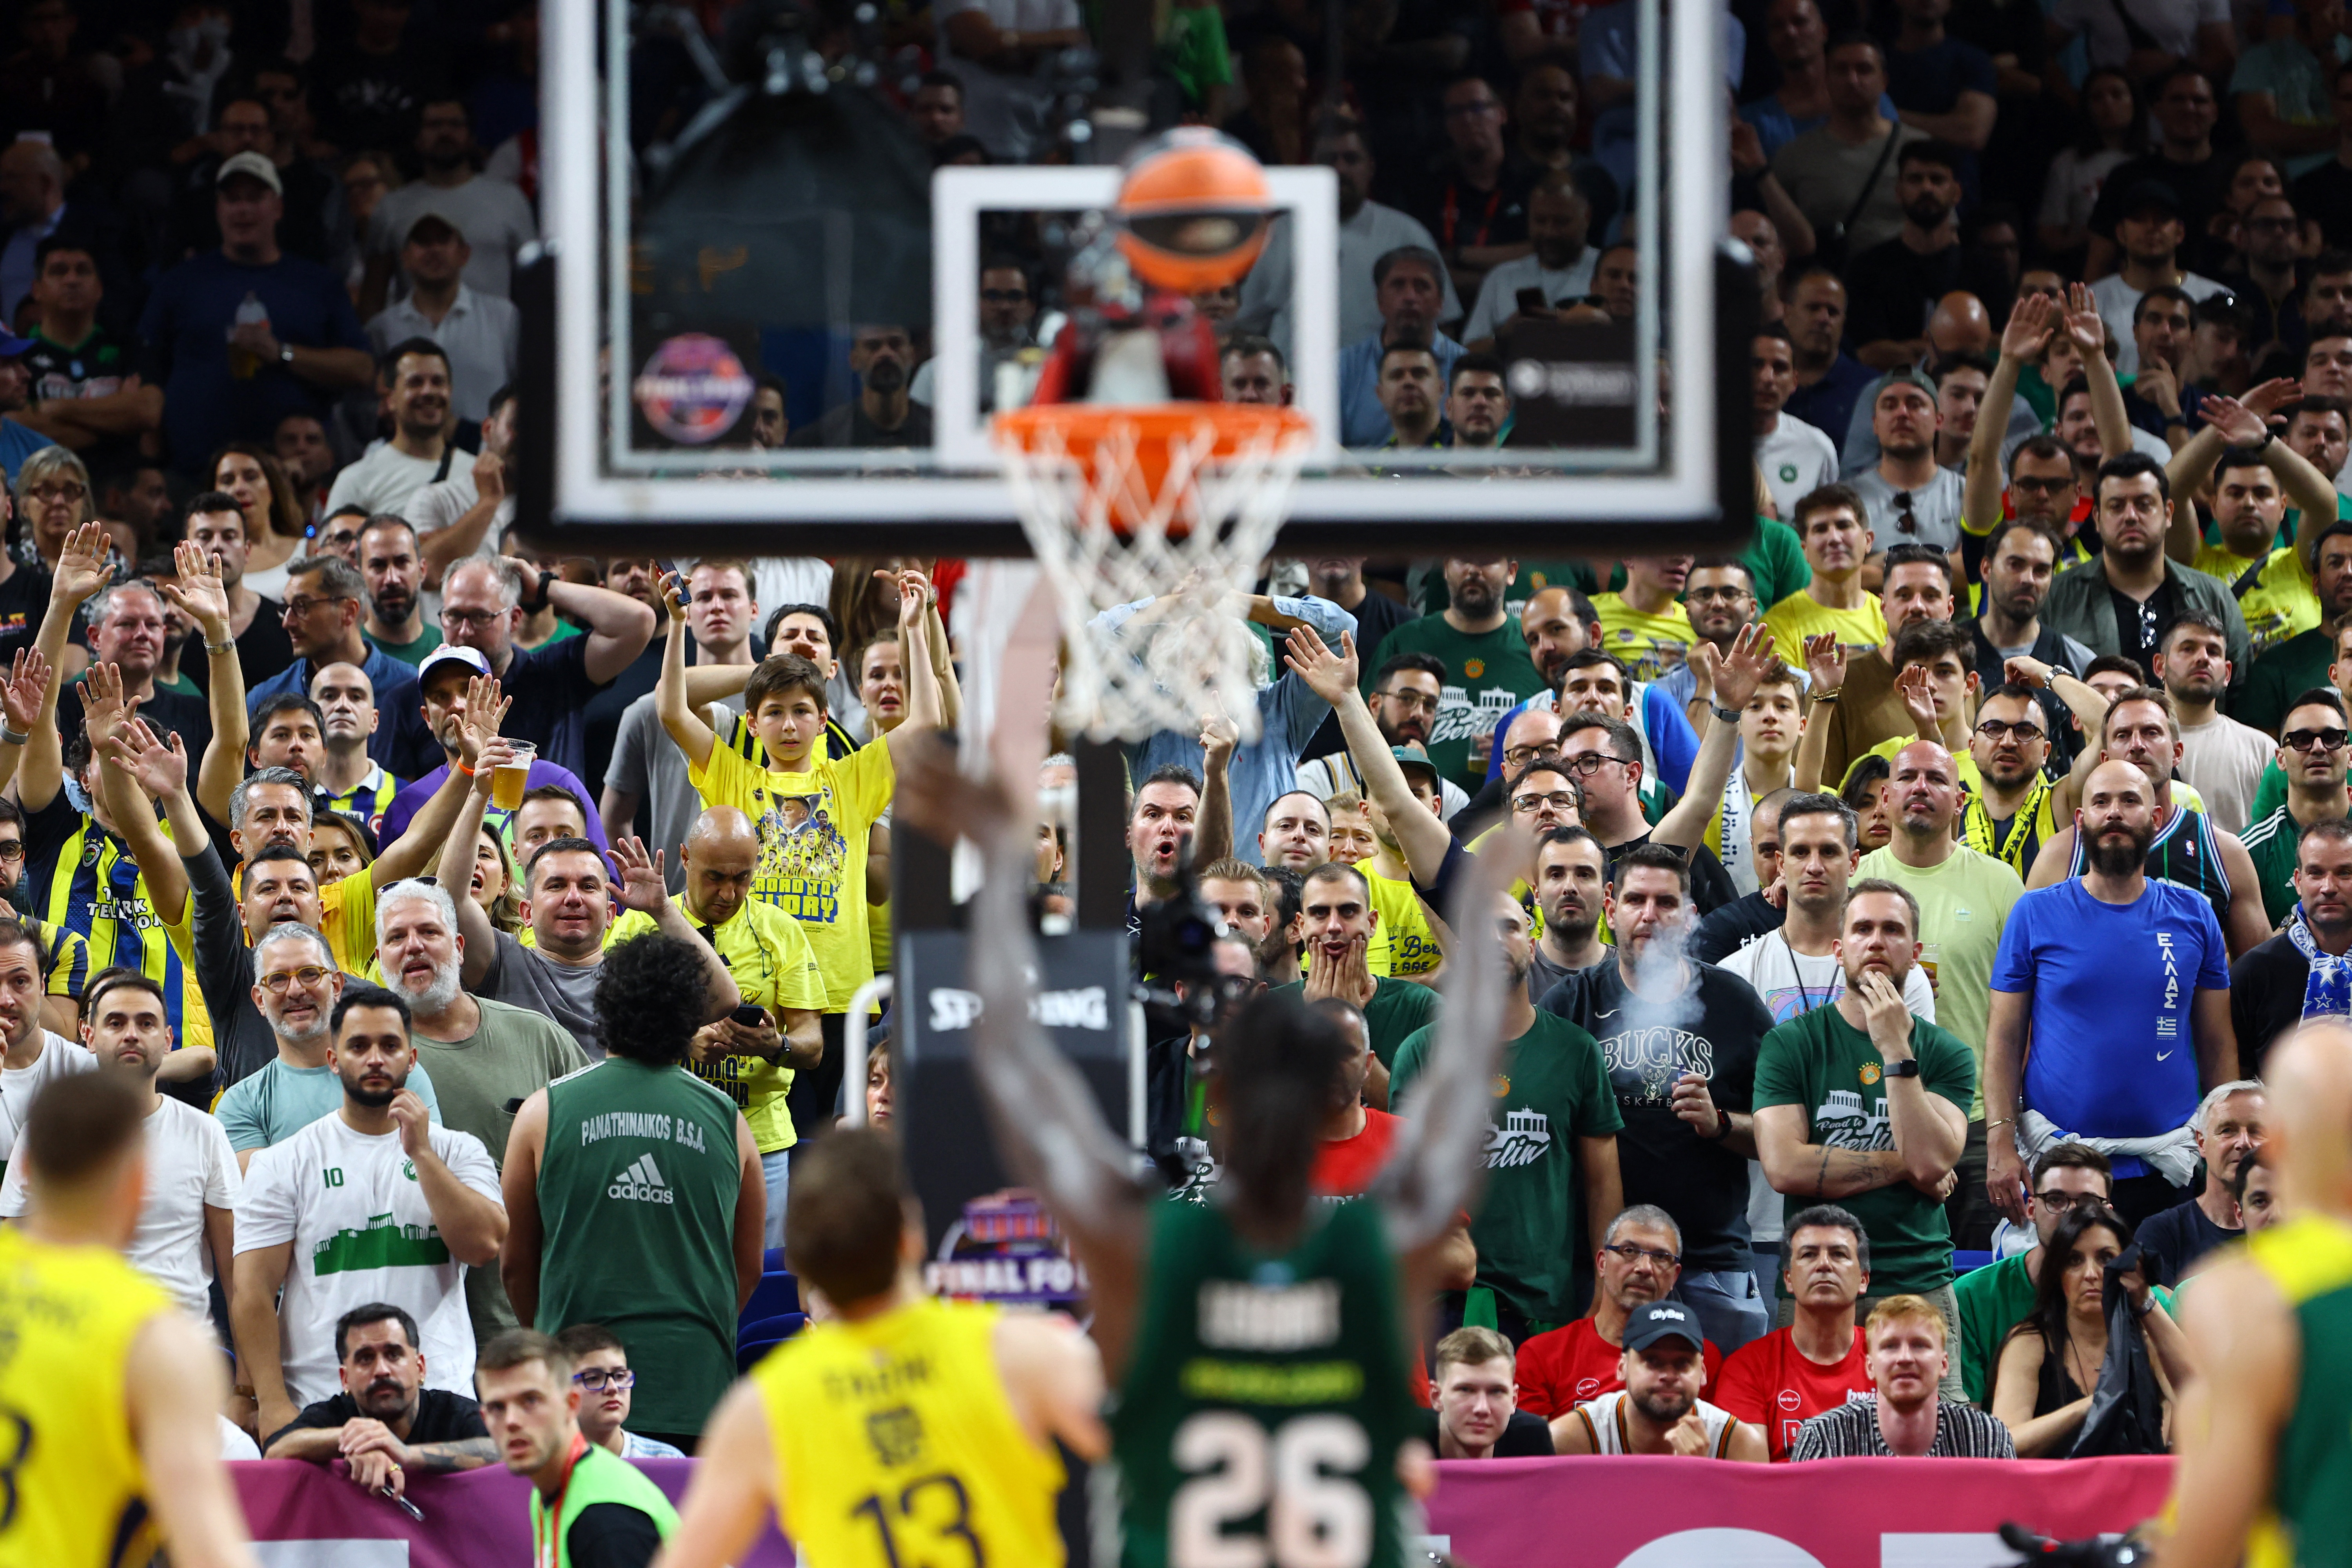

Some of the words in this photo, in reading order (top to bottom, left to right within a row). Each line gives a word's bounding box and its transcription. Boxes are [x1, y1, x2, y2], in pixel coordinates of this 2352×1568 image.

[755, 877, 805, 894] ROAD
[809, 879, 832, 896] TO
[1402, 961, 1429, 971] ARE
[1598, 1025, 1714, 1080] BUCKS
[582, 1112, 671, 1147] PANATHINAIKOS
[676, 1118, 706, 1154] B.S.A.
[1816, 1118, 1852, 1132] Road
[1853, 1117, 1863, 1127] to
[323, 1167, 344, 1189] 10
[1196, 1163, 1210, 1174] to
[608, 1182, 674, 1204] adidas
[1649, 1308, 1685, 1321] OlyBet
[1168, 1412, 1374, 1568] 26
[851, 1473, 985, 1568] 13
